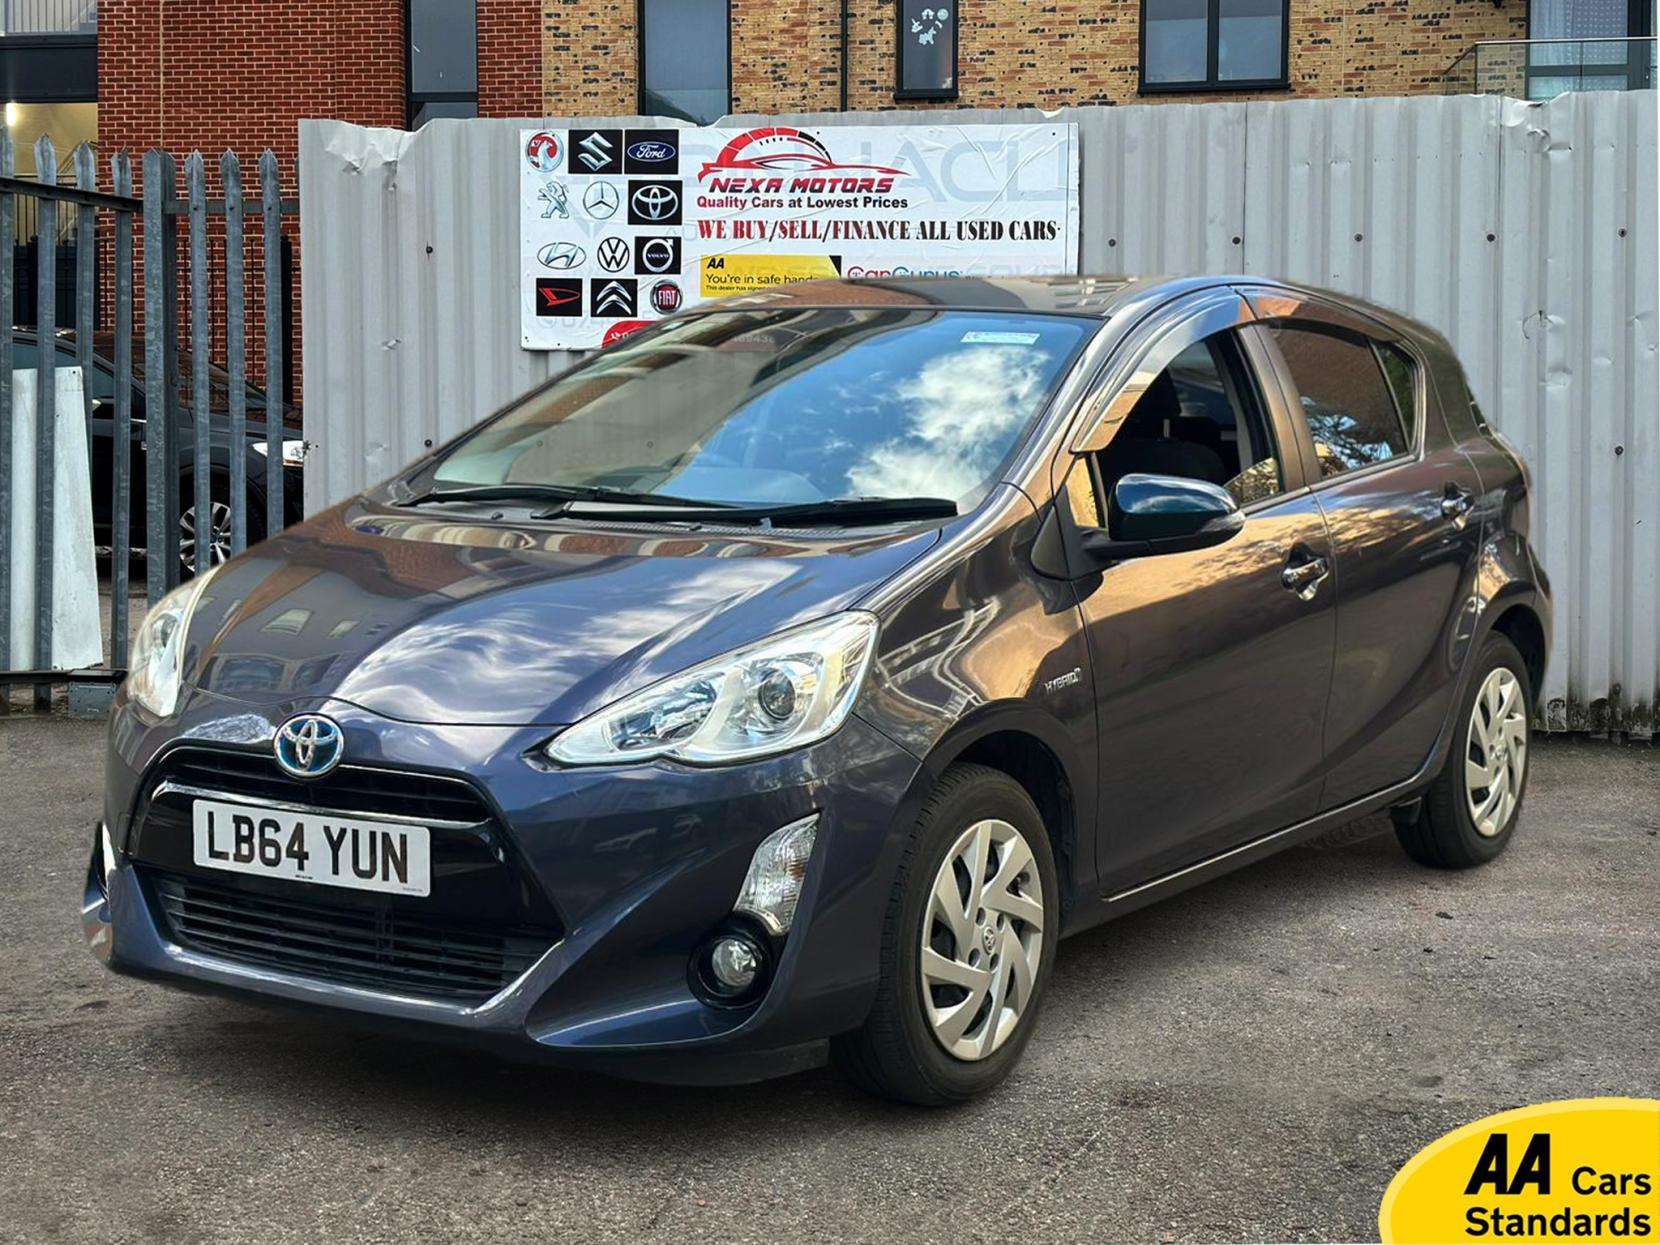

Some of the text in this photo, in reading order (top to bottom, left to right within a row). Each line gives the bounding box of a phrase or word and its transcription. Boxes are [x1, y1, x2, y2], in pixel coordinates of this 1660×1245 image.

[636, 144, 666, 159] Ford
[708, 177, 894, 194] NEXA MOTORS
[697, 195, 908, 211] Quality Cars at Lowest Prices
[697, 219, 727, 240] WE
[916, 219, 951, 241] ALL
[956, 219, 1004, 241] USED
[1008, 219, 1057, 241] CARS
[706, 257, 725, 270] AA
[705, 273, 742, 285] You're
[744, 274, 755, 284] in
[757, 274, 782, 285] safe
[658, 289, 677, 307] FIAT
[207, 810, 409, 884] LB64 YUN
